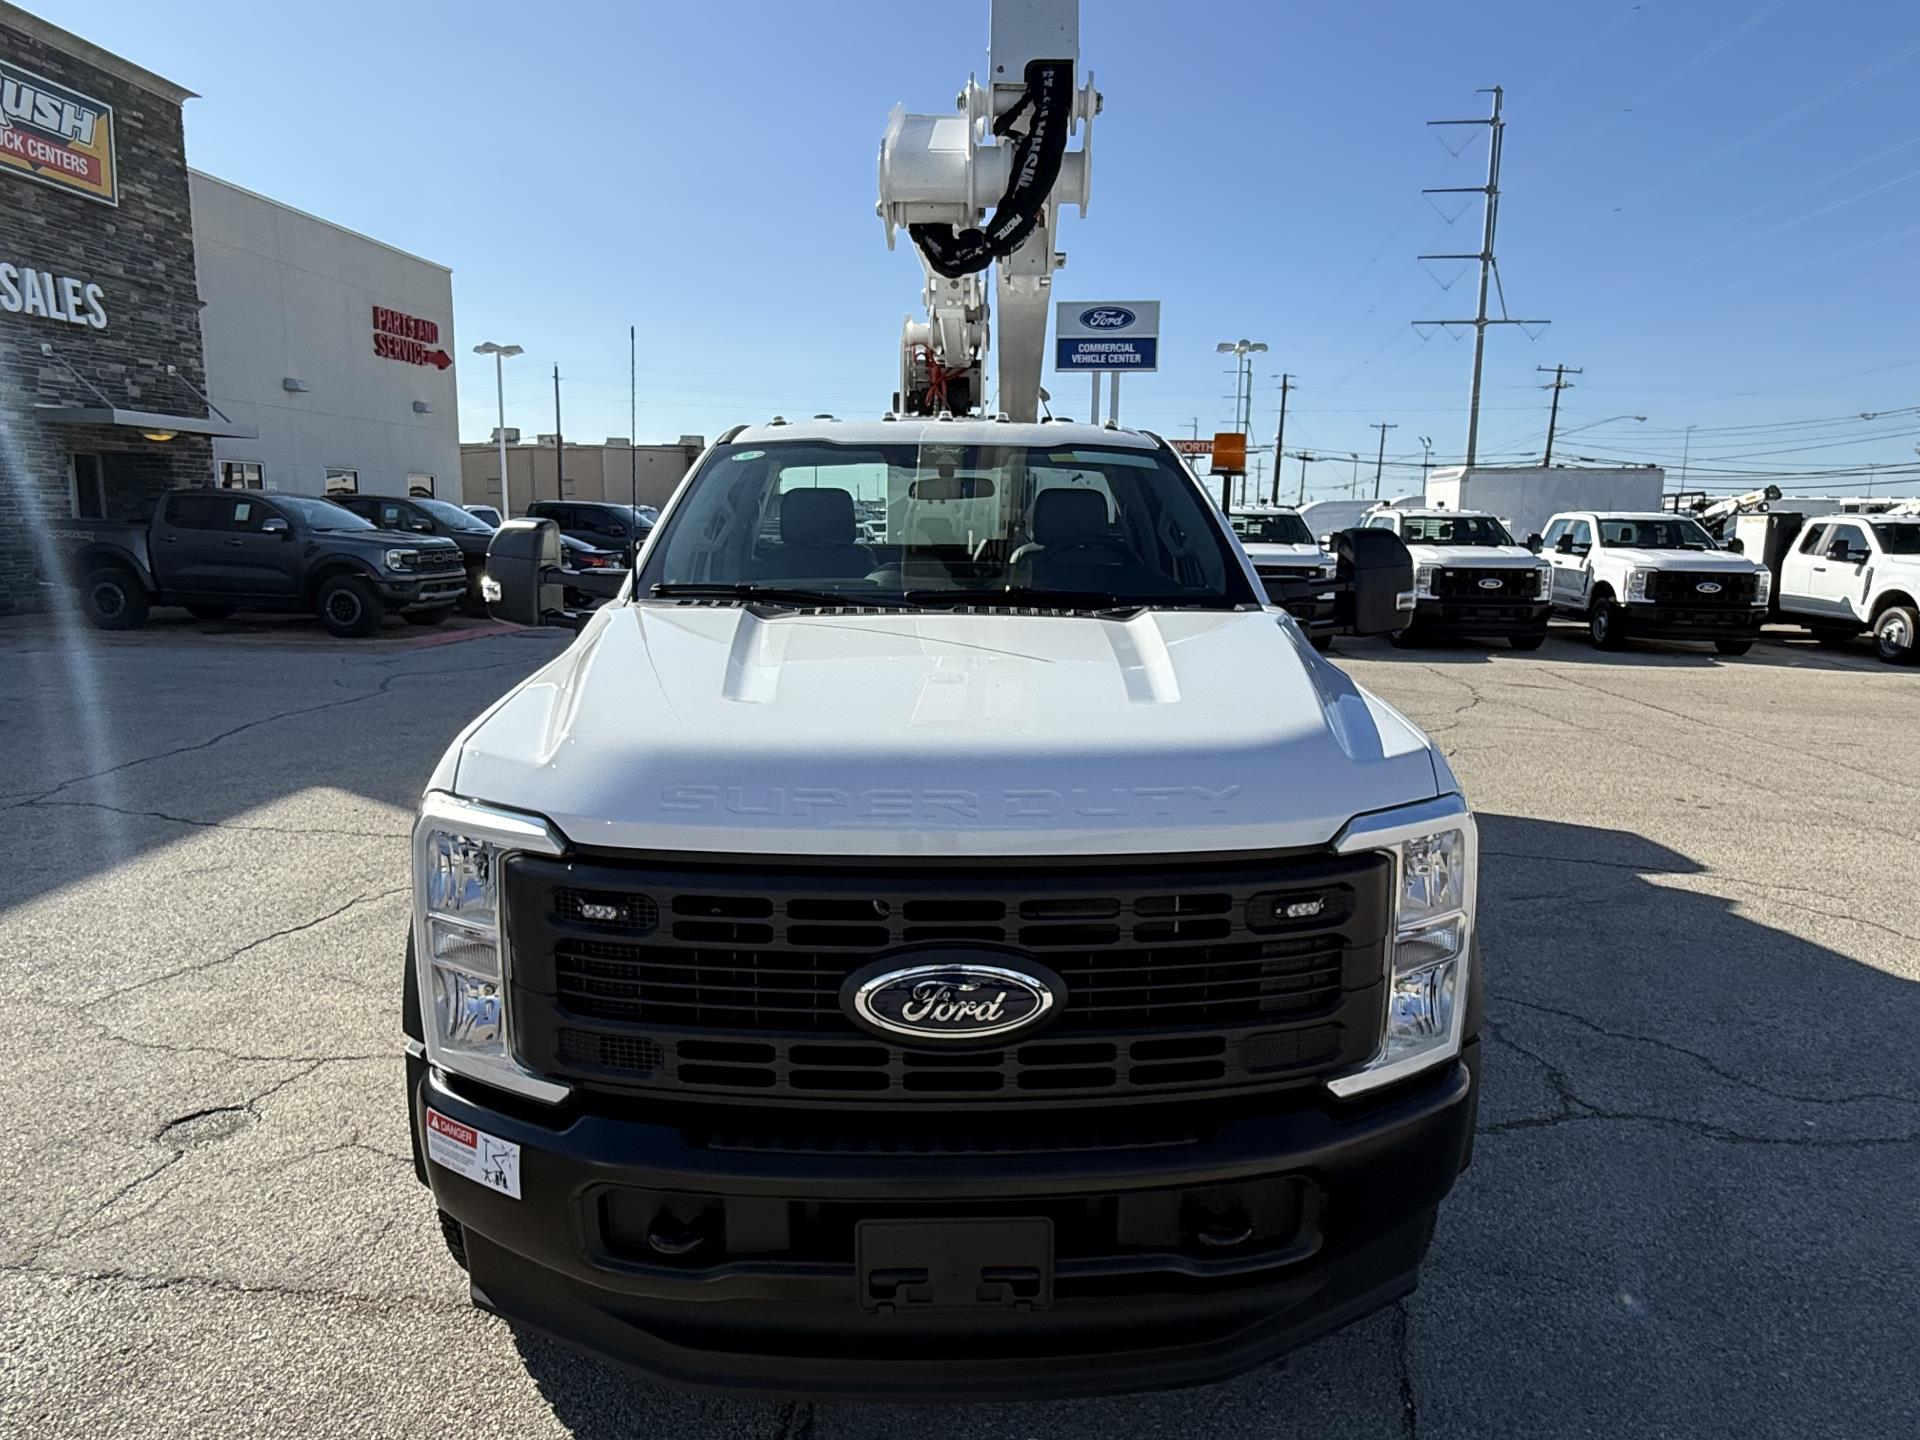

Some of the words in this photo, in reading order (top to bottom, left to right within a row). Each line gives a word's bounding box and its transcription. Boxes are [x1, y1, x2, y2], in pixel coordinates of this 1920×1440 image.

[0, 78, 95, 144] USH
[27, 138, 89, 176] CENTERS
[0, 262, 107, 329] SALES
[374, 306, 416, 339] PARTS
[1089, 310, 1125, 326] Ford
[374, 333, 429, 366] SERVICE
[1071, 354, 1107, 364] VEHICLE
[1108, 353, 1142, 364] CENTER
[1077, 343, 1136, 353] COMMERCIAL
[416, 550, 465, 564] FORD
[659, 784, 979, 818] SUPER
[1003, 784, 1243, 818] DUTY
[901, 979, 1007, 1023] Ford
[440, 1120, 473, 1145] DANGER
